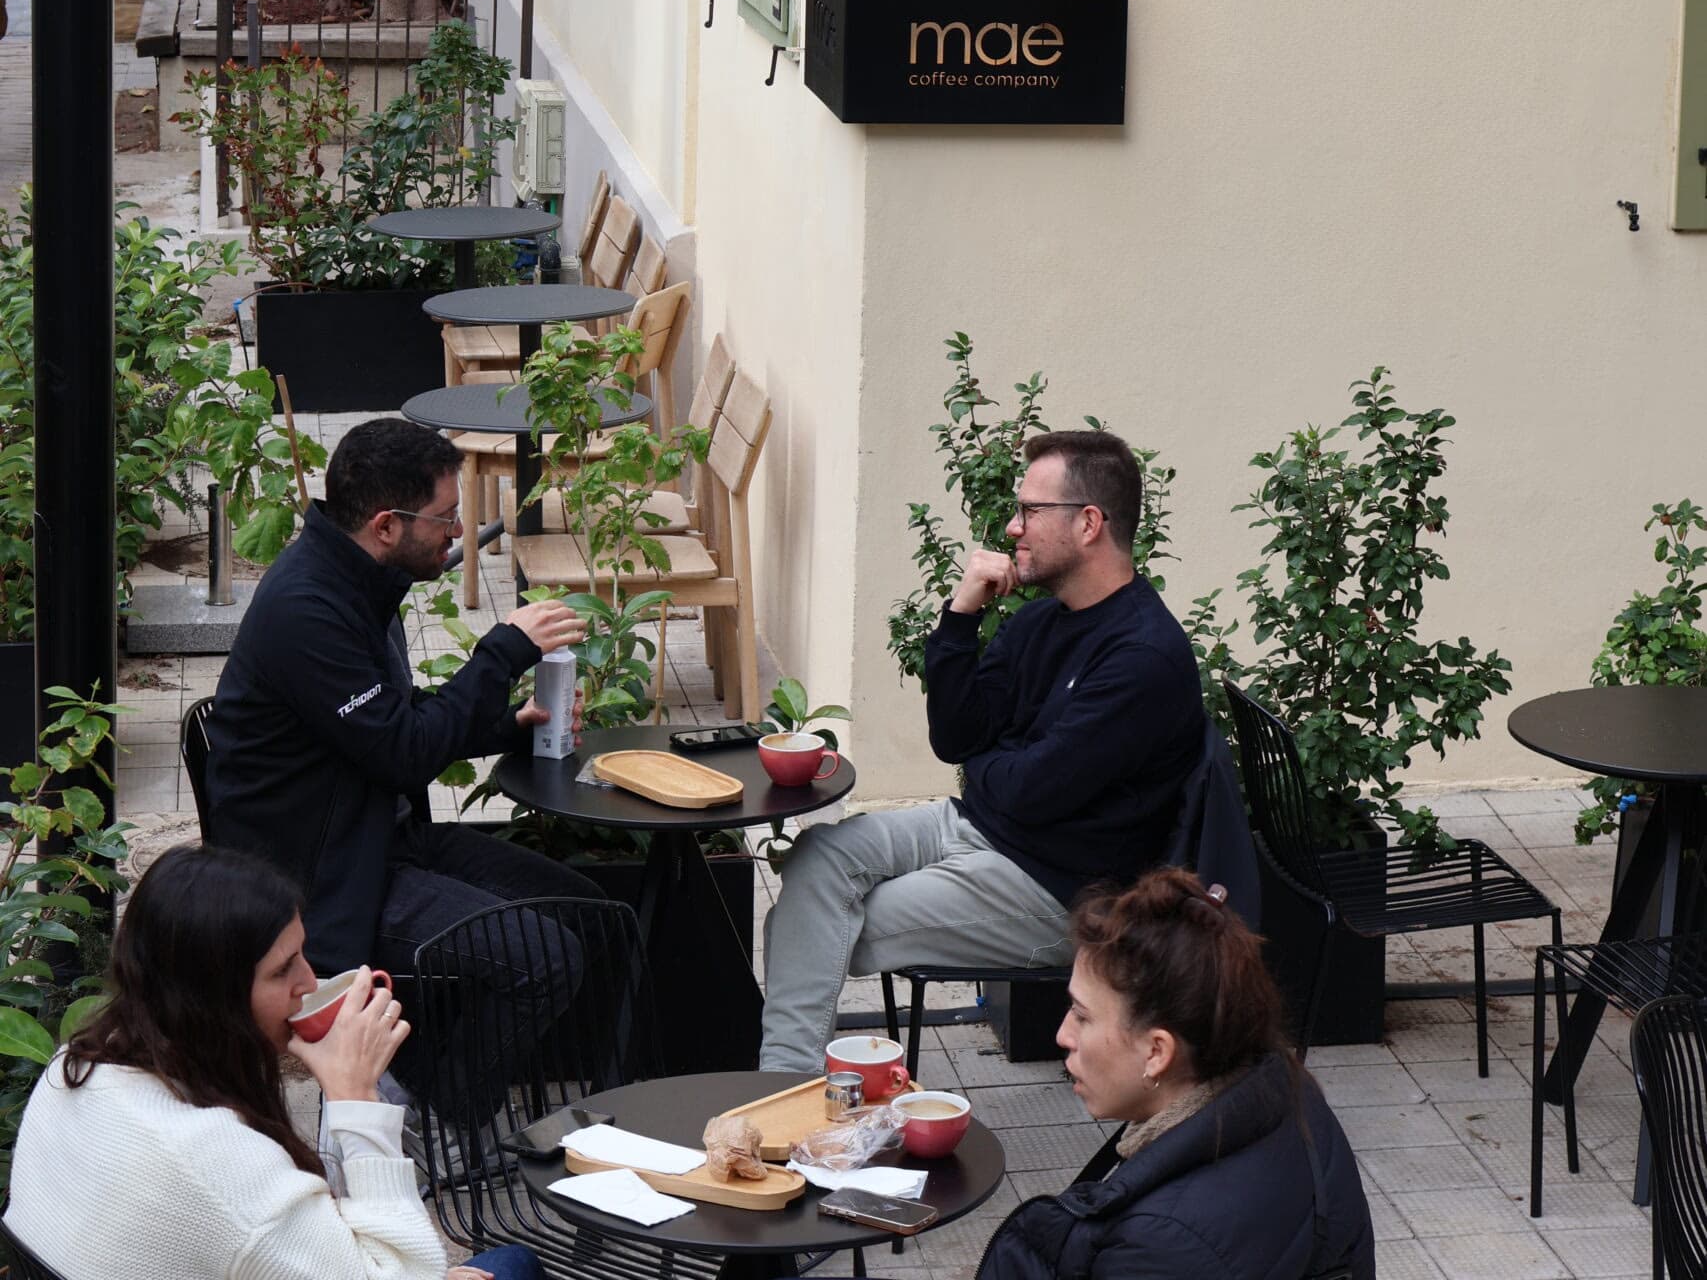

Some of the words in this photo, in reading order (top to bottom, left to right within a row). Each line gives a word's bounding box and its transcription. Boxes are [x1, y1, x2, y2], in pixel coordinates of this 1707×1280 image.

[909, 20, 1065, 66] mae
[908, 71, 969, 87] coffee
[974, 72, 1061, 89] company
